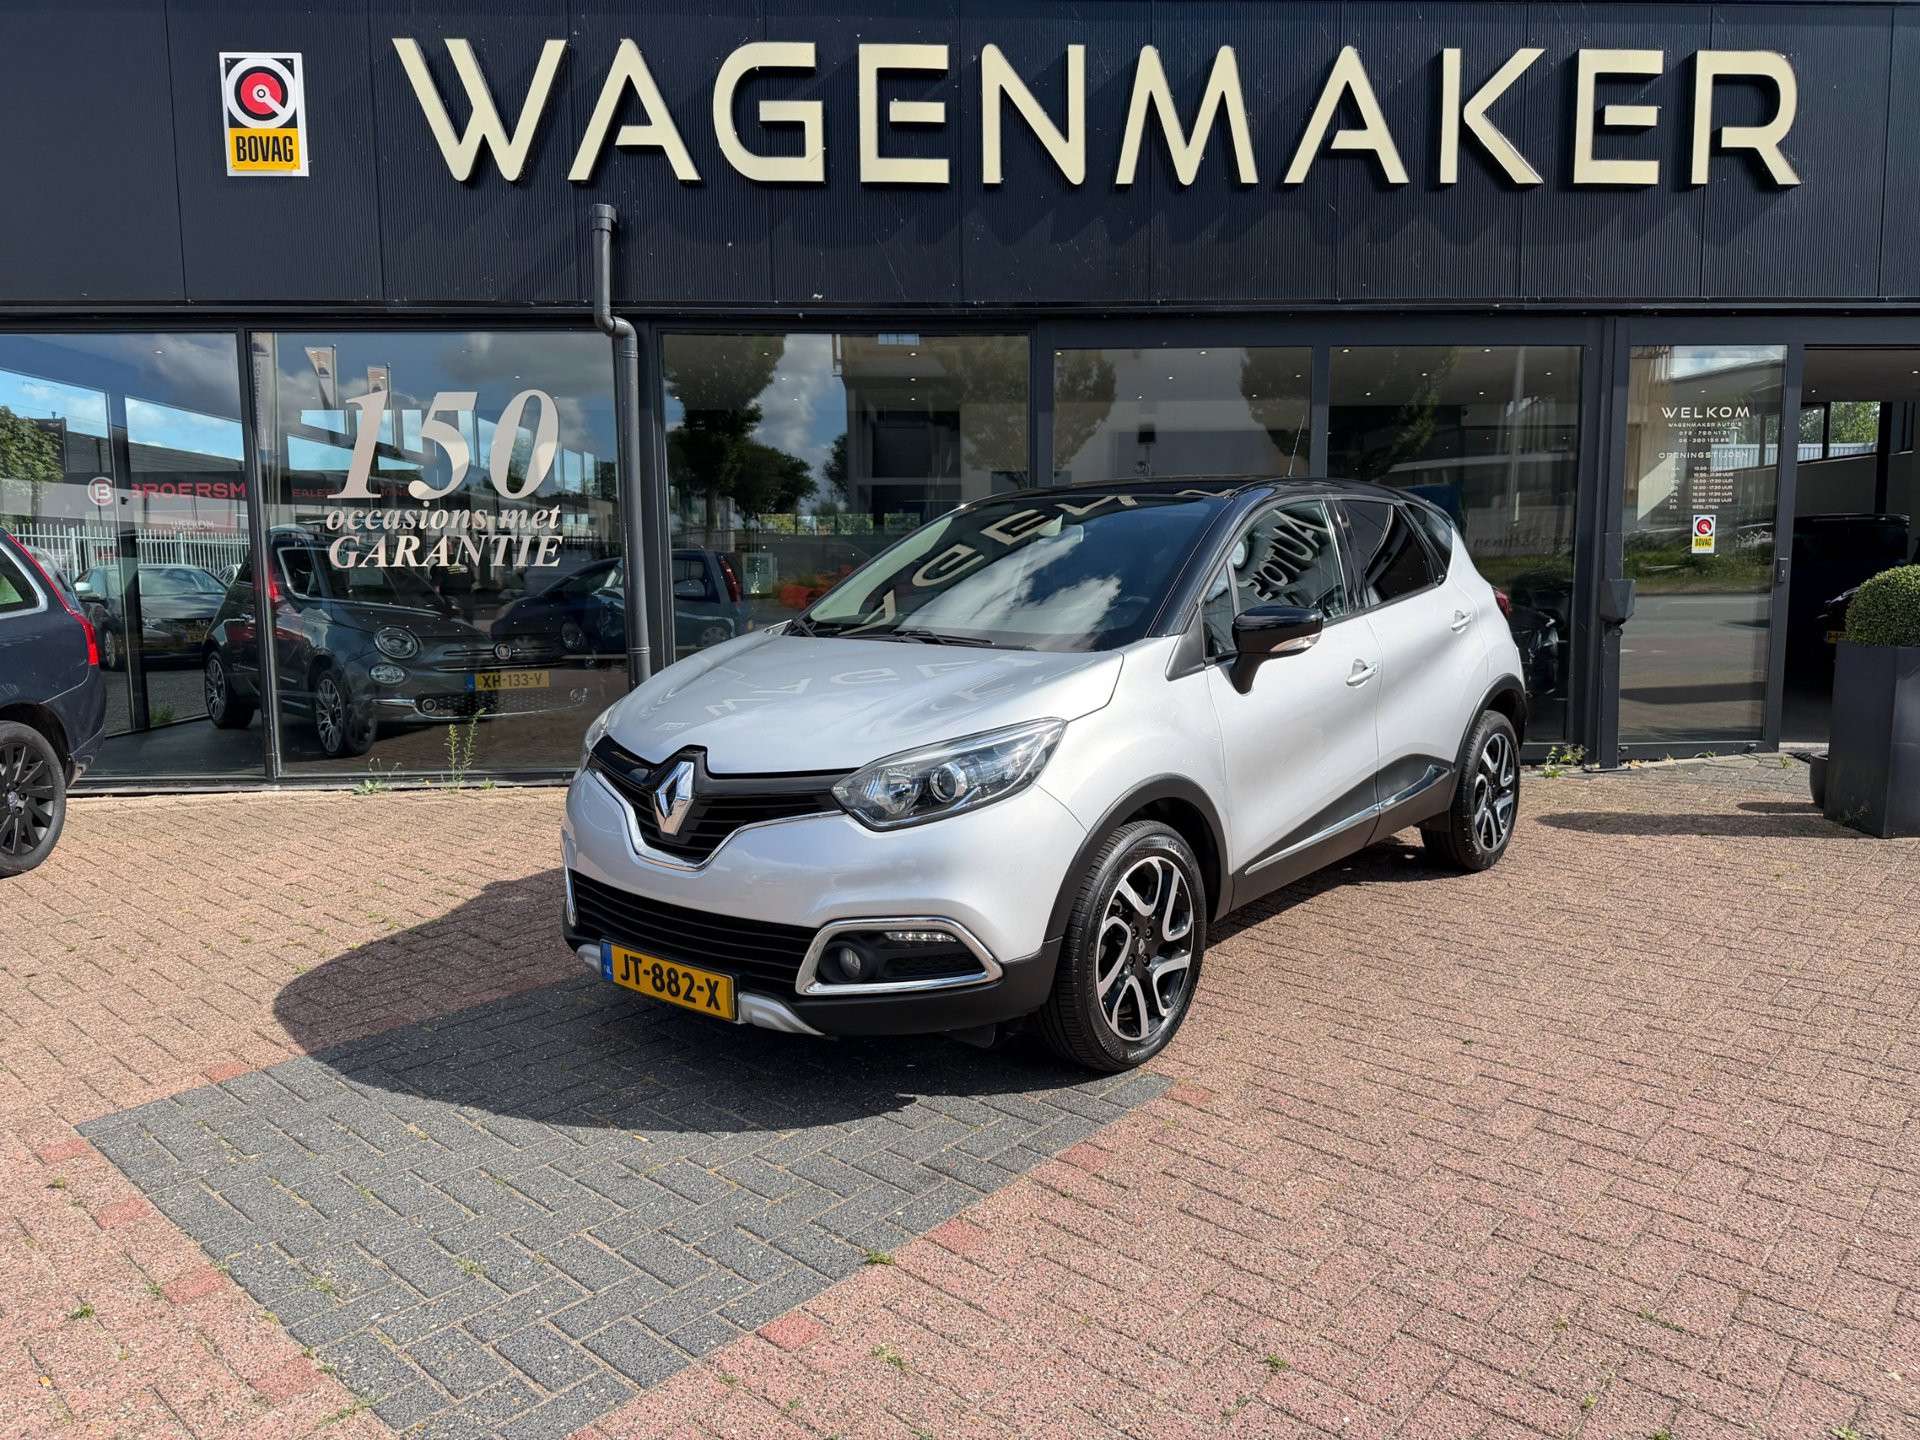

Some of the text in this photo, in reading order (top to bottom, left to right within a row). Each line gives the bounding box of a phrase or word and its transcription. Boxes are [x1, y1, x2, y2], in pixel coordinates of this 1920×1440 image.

[391, 37, 1801, 187] WAGENMAKER
[235, 135, 294, 163] BOVAG
[1661, 406, 1750, 419] WELKOM
[327, 388, 560, 500] 150
[1658, 451, 1749, 460] OPENINGSTIJDEN
[326, 501, 561, 531] occasions met
[327, 534, 564, 569] GARANTIE
[1694, 537, 1712, 547] BOVAG
[481, 673, 543, 689] XH-133-V
[620, 953, 721, 1011] JT-882-X
